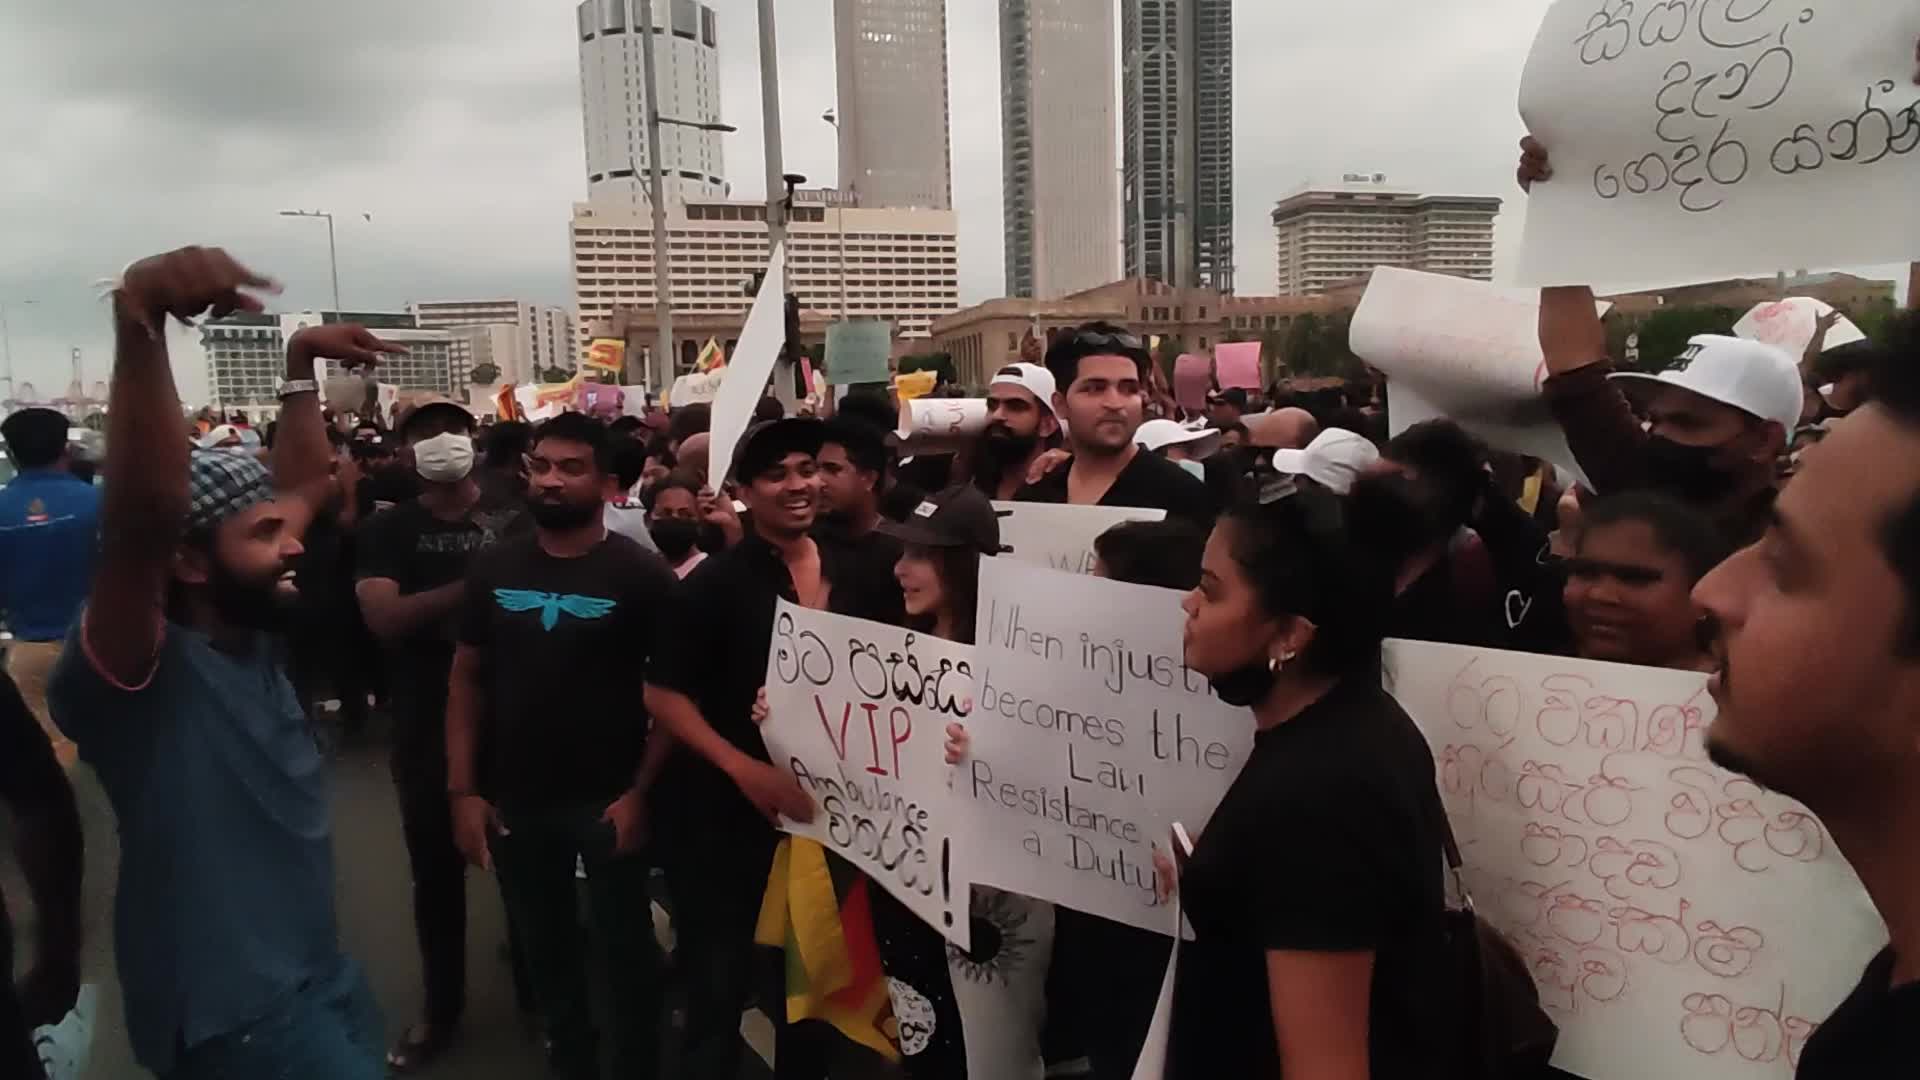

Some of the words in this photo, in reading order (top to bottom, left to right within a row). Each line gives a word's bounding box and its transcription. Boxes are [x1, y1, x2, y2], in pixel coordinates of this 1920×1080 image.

[1594, 118, 1748, 212] ගෙදර
[988, 599, 1063, 660] When
[814, 694, 912, 780] VIP
[980, 667, 1125, 747] becomes
[1153, 708, 1230, 771] the
[790, 756, 929, 833] Ambulance
[971, 759, 1142, 844] Resistance
[1022, 829, 1042, 857] a
[1064, 833, 1161, 906] Duty
